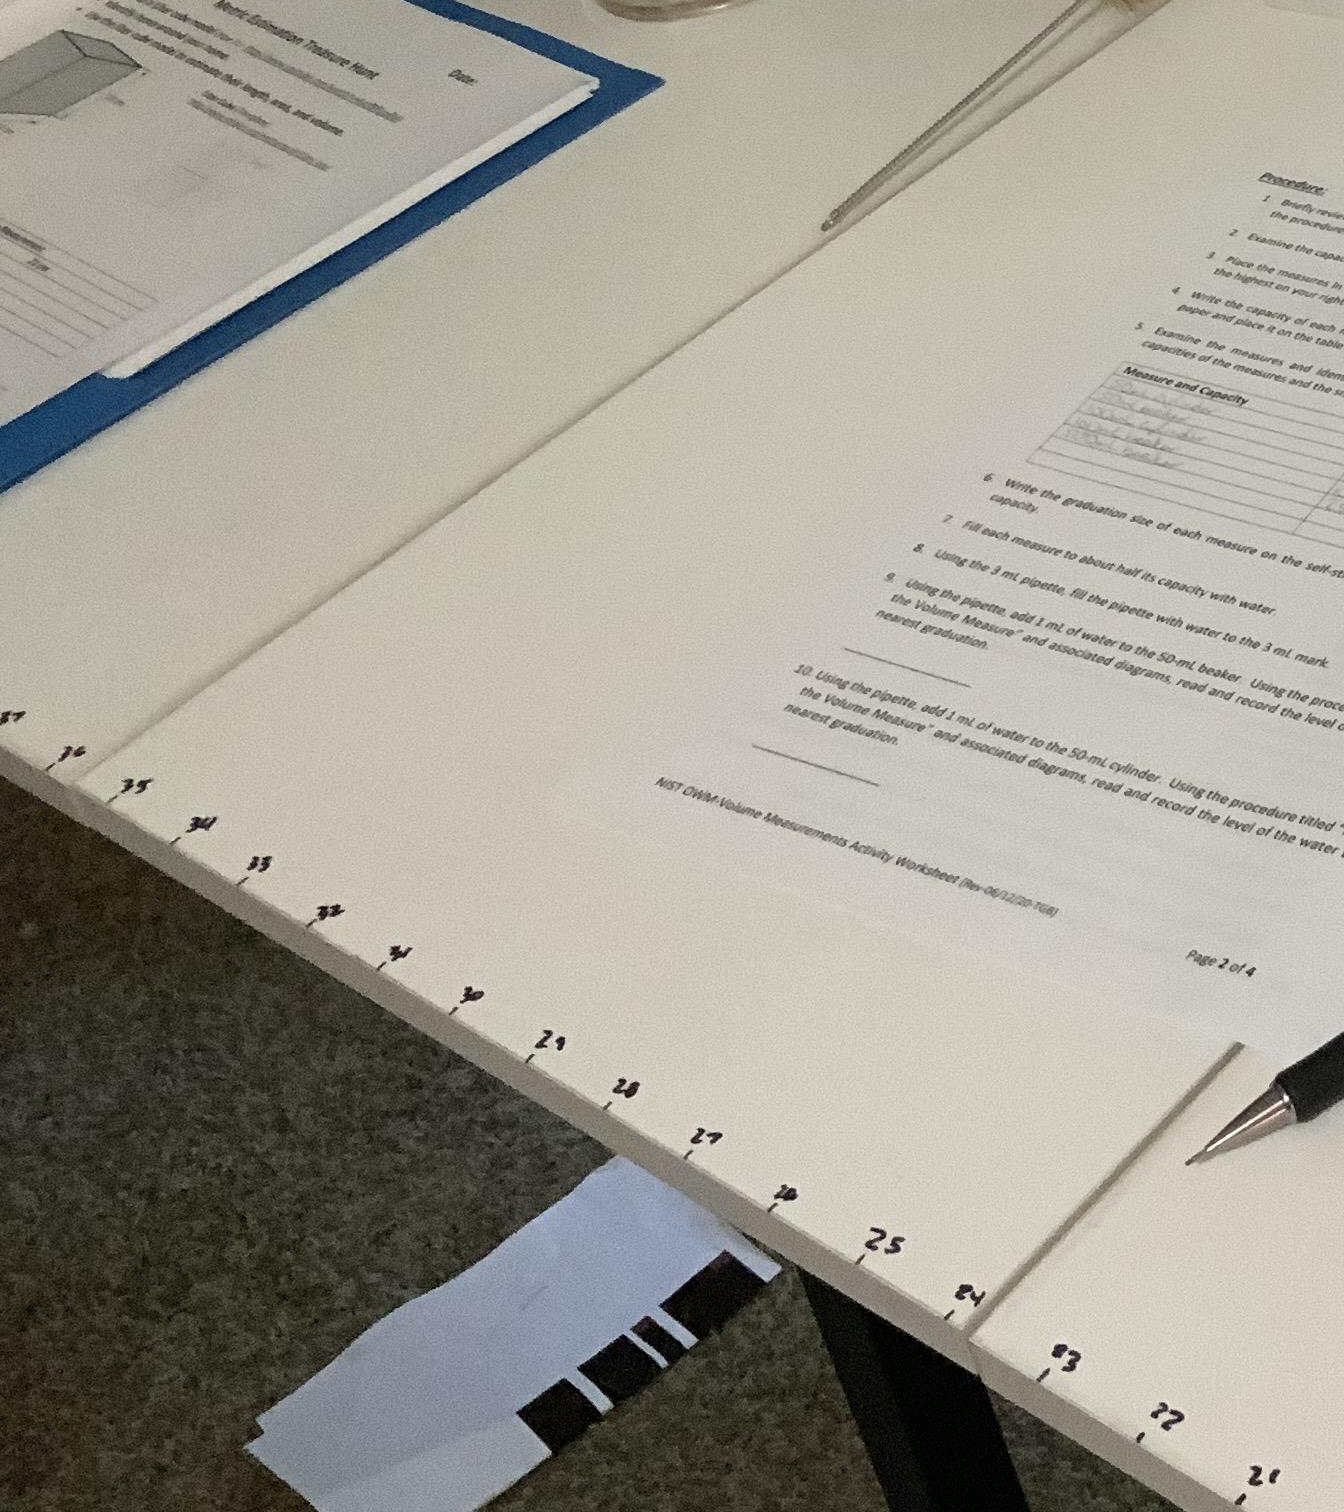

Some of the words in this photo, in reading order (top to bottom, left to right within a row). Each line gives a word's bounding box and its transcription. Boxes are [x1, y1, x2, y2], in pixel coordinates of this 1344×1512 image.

[302, 38, 352, 68] Treasure
[348, 61, 381, 81] Hunt
[1258, 173, 1325, 196] Procedure:
[1280, 198, 1316, 214] Briefly
[1123, 366, 1174, 385] Measure
[1173, 380, 1200, 392] and
[1199, 386, 1249, 407] Capacity
[654, 776, 684, 792] NIST
[682, 785, 762, 818] OWM-Volume
[763, 812, 847, 847] Measurements
[848, 840, 894, 864] Activity
[895, 856, 960, 884] Worksheet
[1185, 949, 1218, 967] Page
[864, 1226, 906, 1255] 25
[1247, 1464, 1282, 1487] 21
